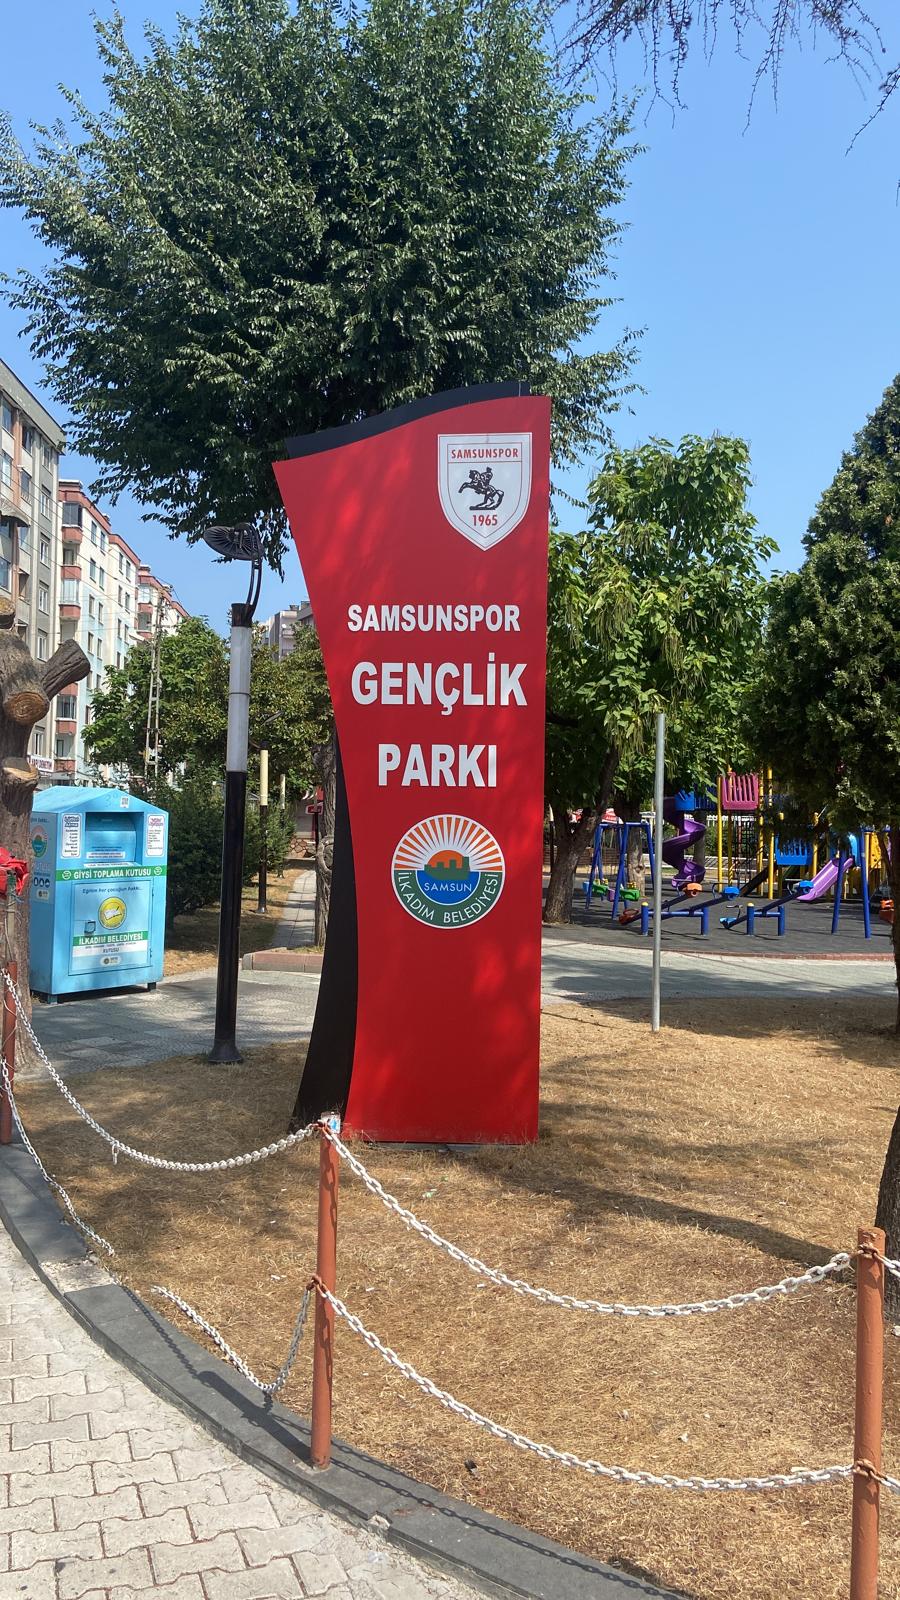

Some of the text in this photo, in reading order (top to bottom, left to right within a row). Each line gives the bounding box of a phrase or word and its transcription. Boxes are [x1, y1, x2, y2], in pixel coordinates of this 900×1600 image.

[451, 448, 519, 459] SAMSUNSPOR
[472, 514, 498, 527] 1965
[347, 604, 521, 632] SAMSUNSPOR
[351, 652, 528, 716] GENÇLİK
[378, 743, 497, 788] PARKI
[73, 868, 152, 880] GİYSİ TOPLAMA KUTUSU
[423, 882, 472, 892] SAMSUN
[398, 872, 499, 923] İLKADIM BELEDİYESİ
[78, 932, 144, 945] İLKADIM BELEDİYESİ
